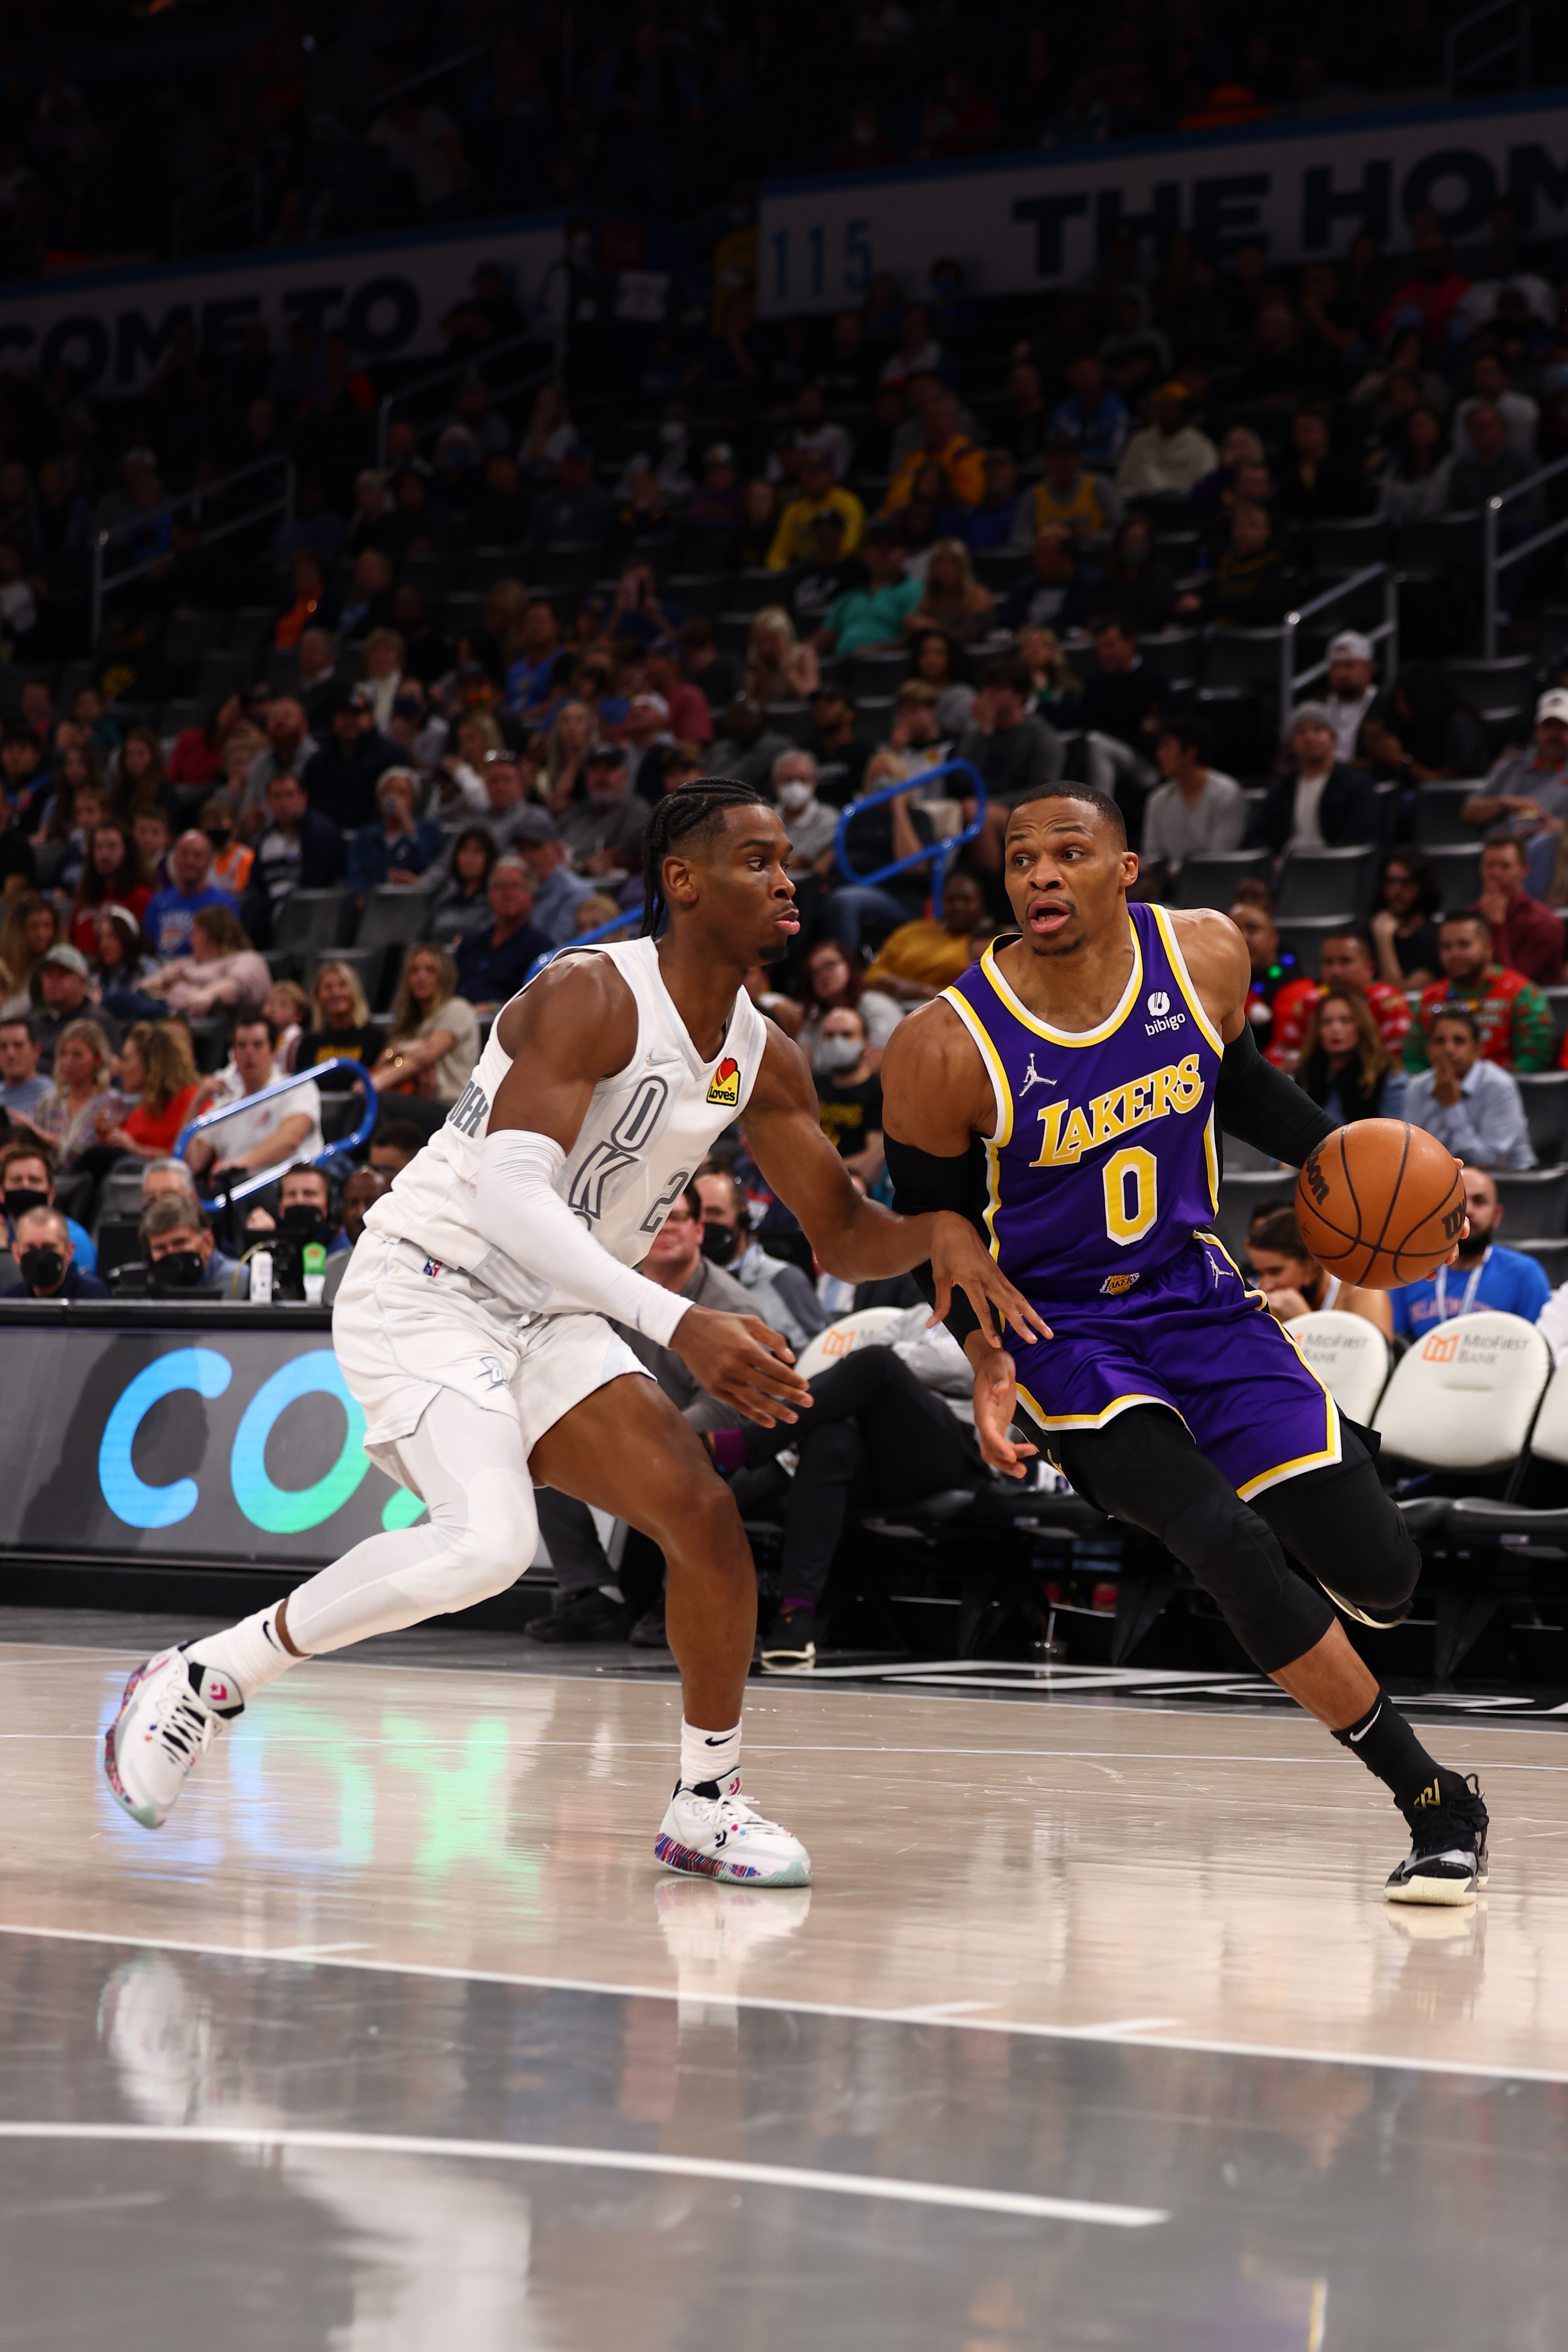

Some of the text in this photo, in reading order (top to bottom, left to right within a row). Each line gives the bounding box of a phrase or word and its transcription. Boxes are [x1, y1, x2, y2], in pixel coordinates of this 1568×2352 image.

[774, 219, 873, 298] 115
[1014, 173, 1269, 277] THE
[1144, 1013, 1186, 1036] bibigo
[1028, 1053, 1205, 1167] LAKERS
[635, 1167, 693, 1238] 2
[1102, 1145, 1157, 1246] 0
[1099, 1272, 1141, 1294] LAKERS
[99, 1347, 427, 1534] CO
